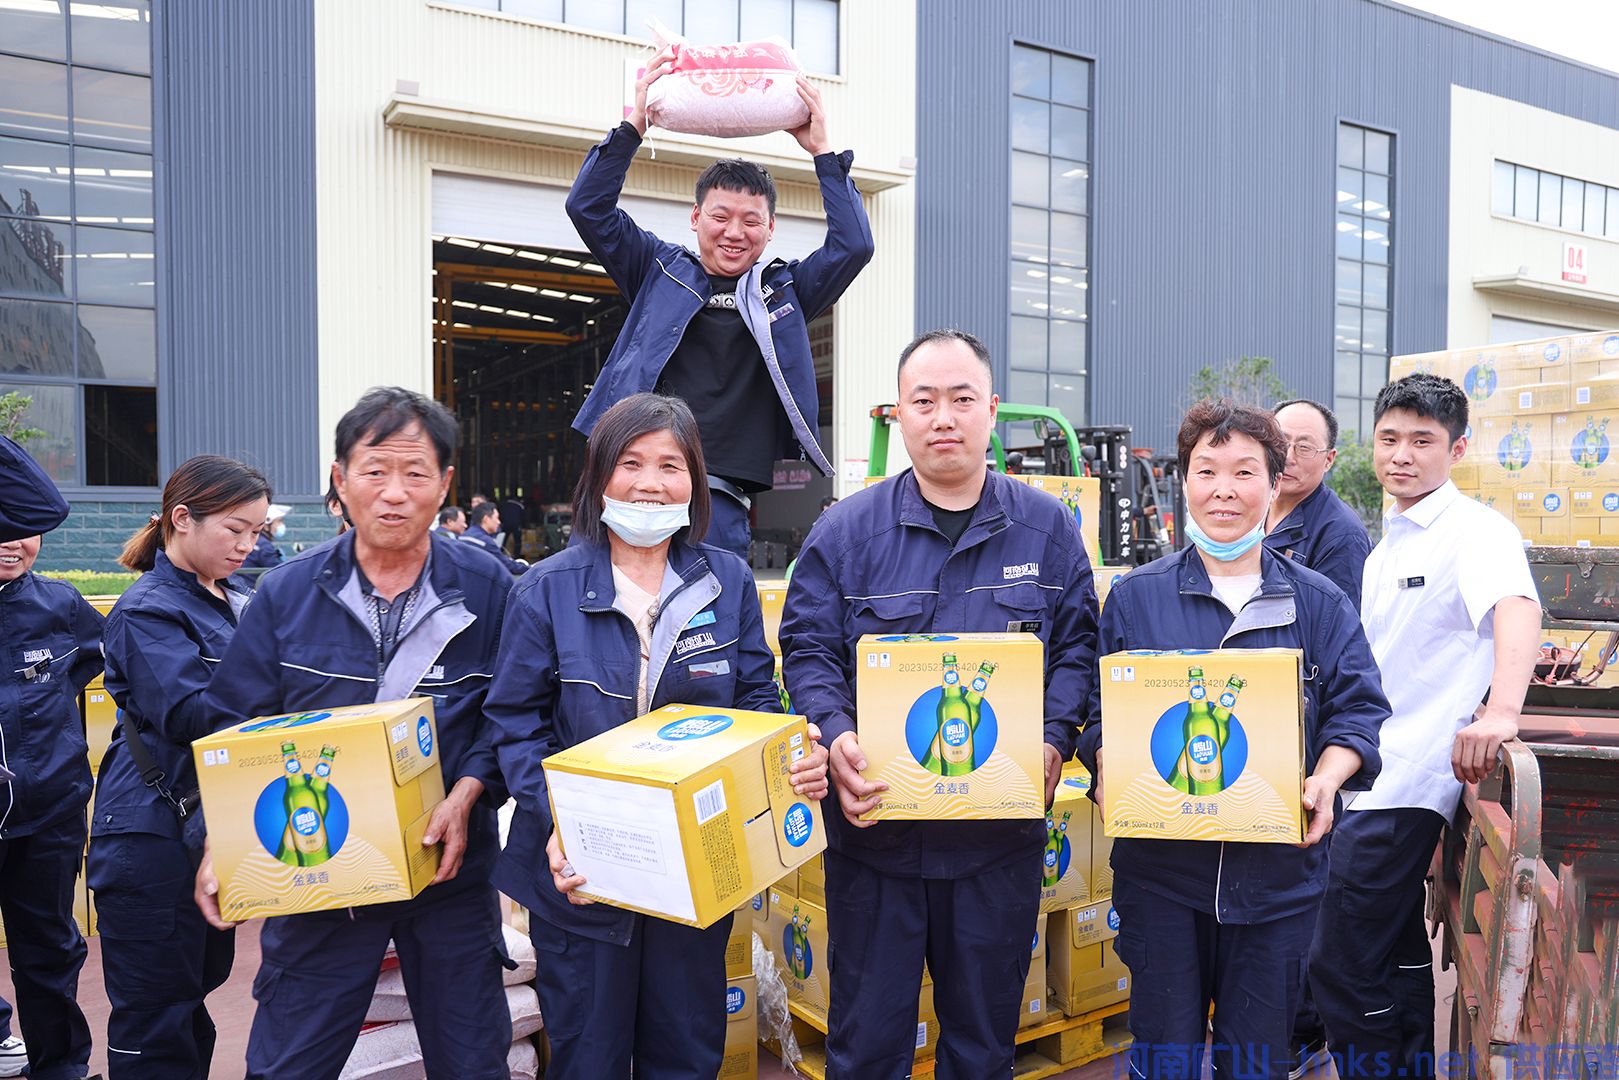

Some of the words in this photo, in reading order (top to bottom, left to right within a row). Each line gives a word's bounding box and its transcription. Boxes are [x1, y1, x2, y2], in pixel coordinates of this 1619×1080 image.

[1568, 247, 1583, 270] 04
[1120, 509, 1131, 558] 中力叉车
[899, 663, 944, 672] 20230523
[1144, 679, 1190, 688] 20230523
[934, 782, 969, 795] 金麦香
[1181, 801, 1218, 815] 金麦香
[293, 871, 329, 887] 金麦香
